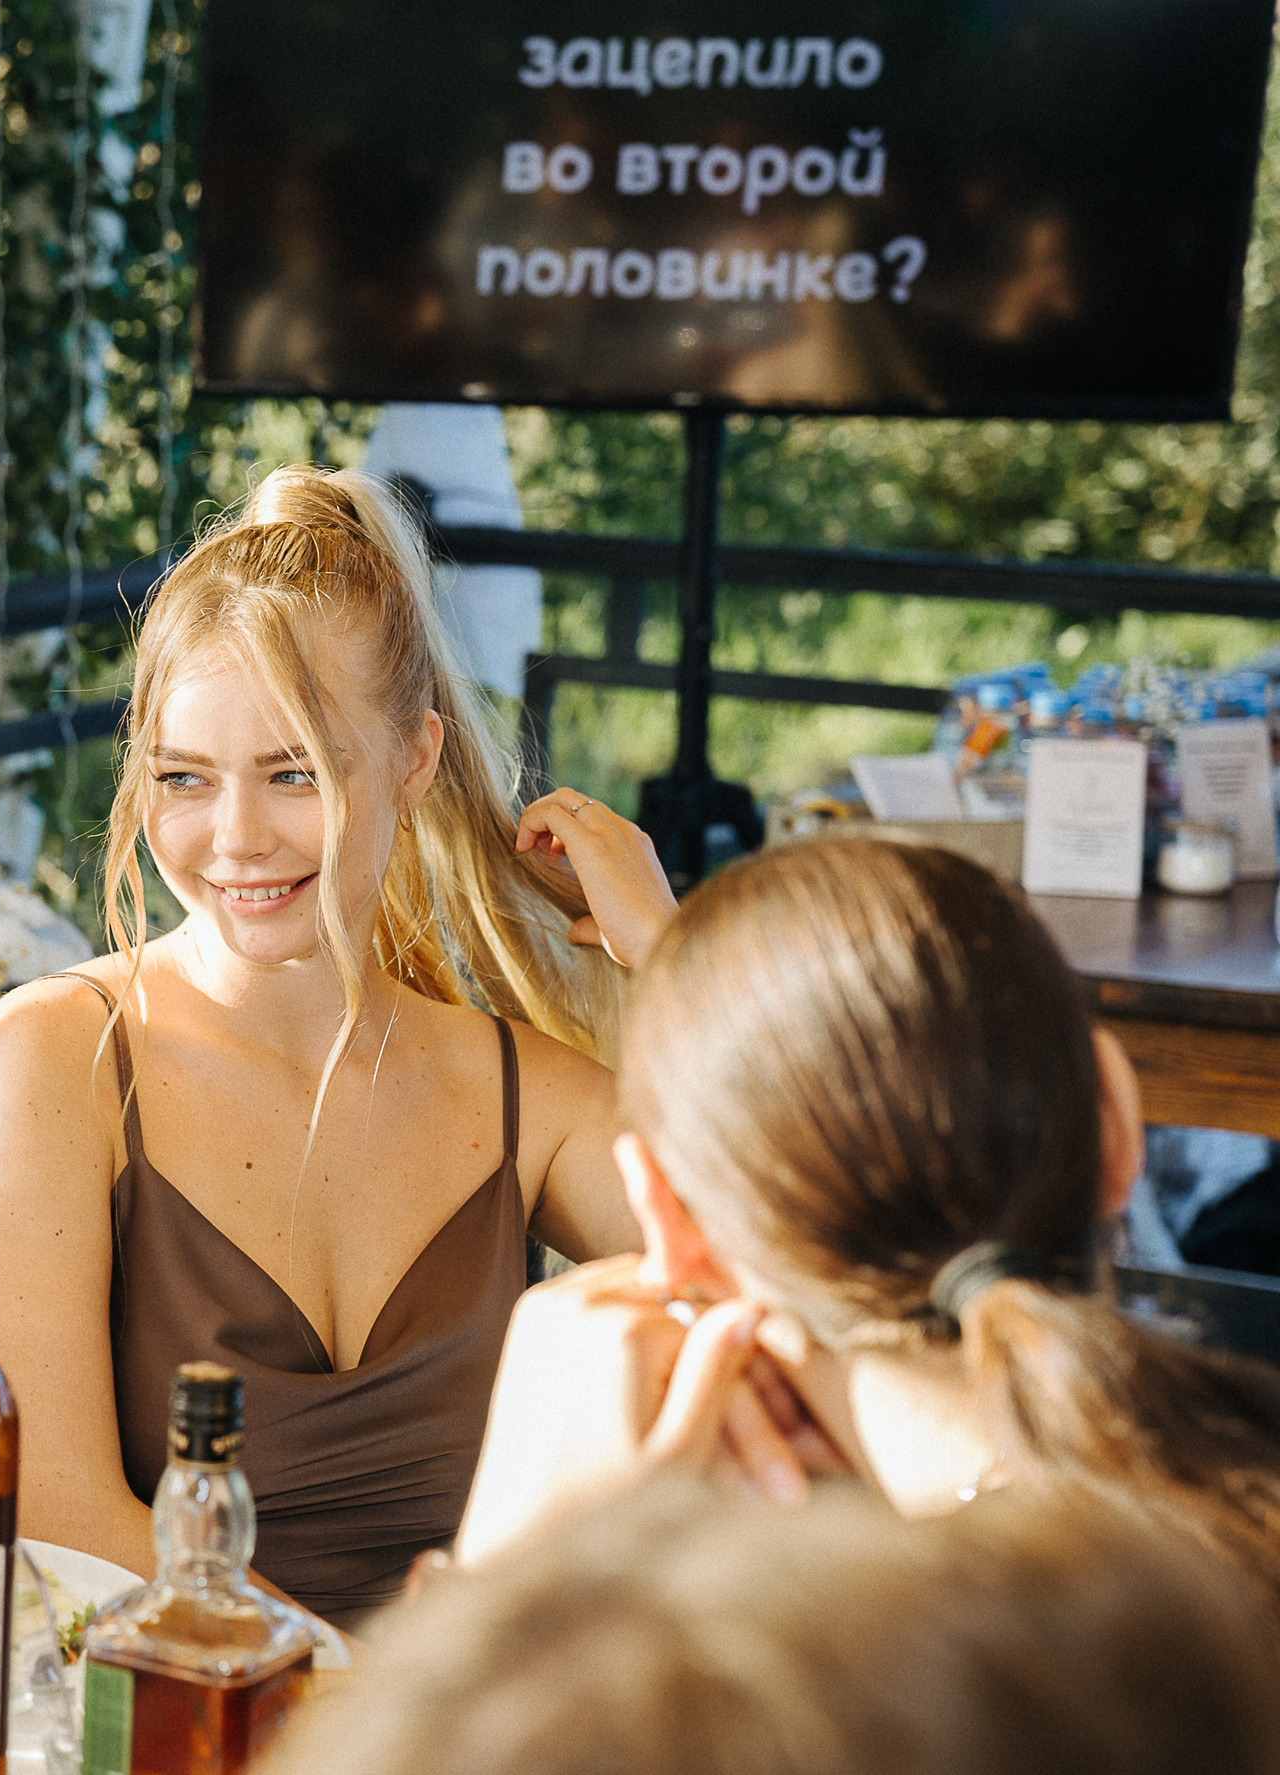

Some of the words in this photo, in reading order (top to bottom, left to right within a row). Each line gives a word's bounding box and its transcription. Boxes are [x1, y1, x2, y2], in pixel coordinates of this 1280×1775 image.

[519, 35, 884, 96] зацепило
[502, 141, 594, 194] во
[616, 127, 886, 215] второй
[475, 235, 927, 303] половинке?
